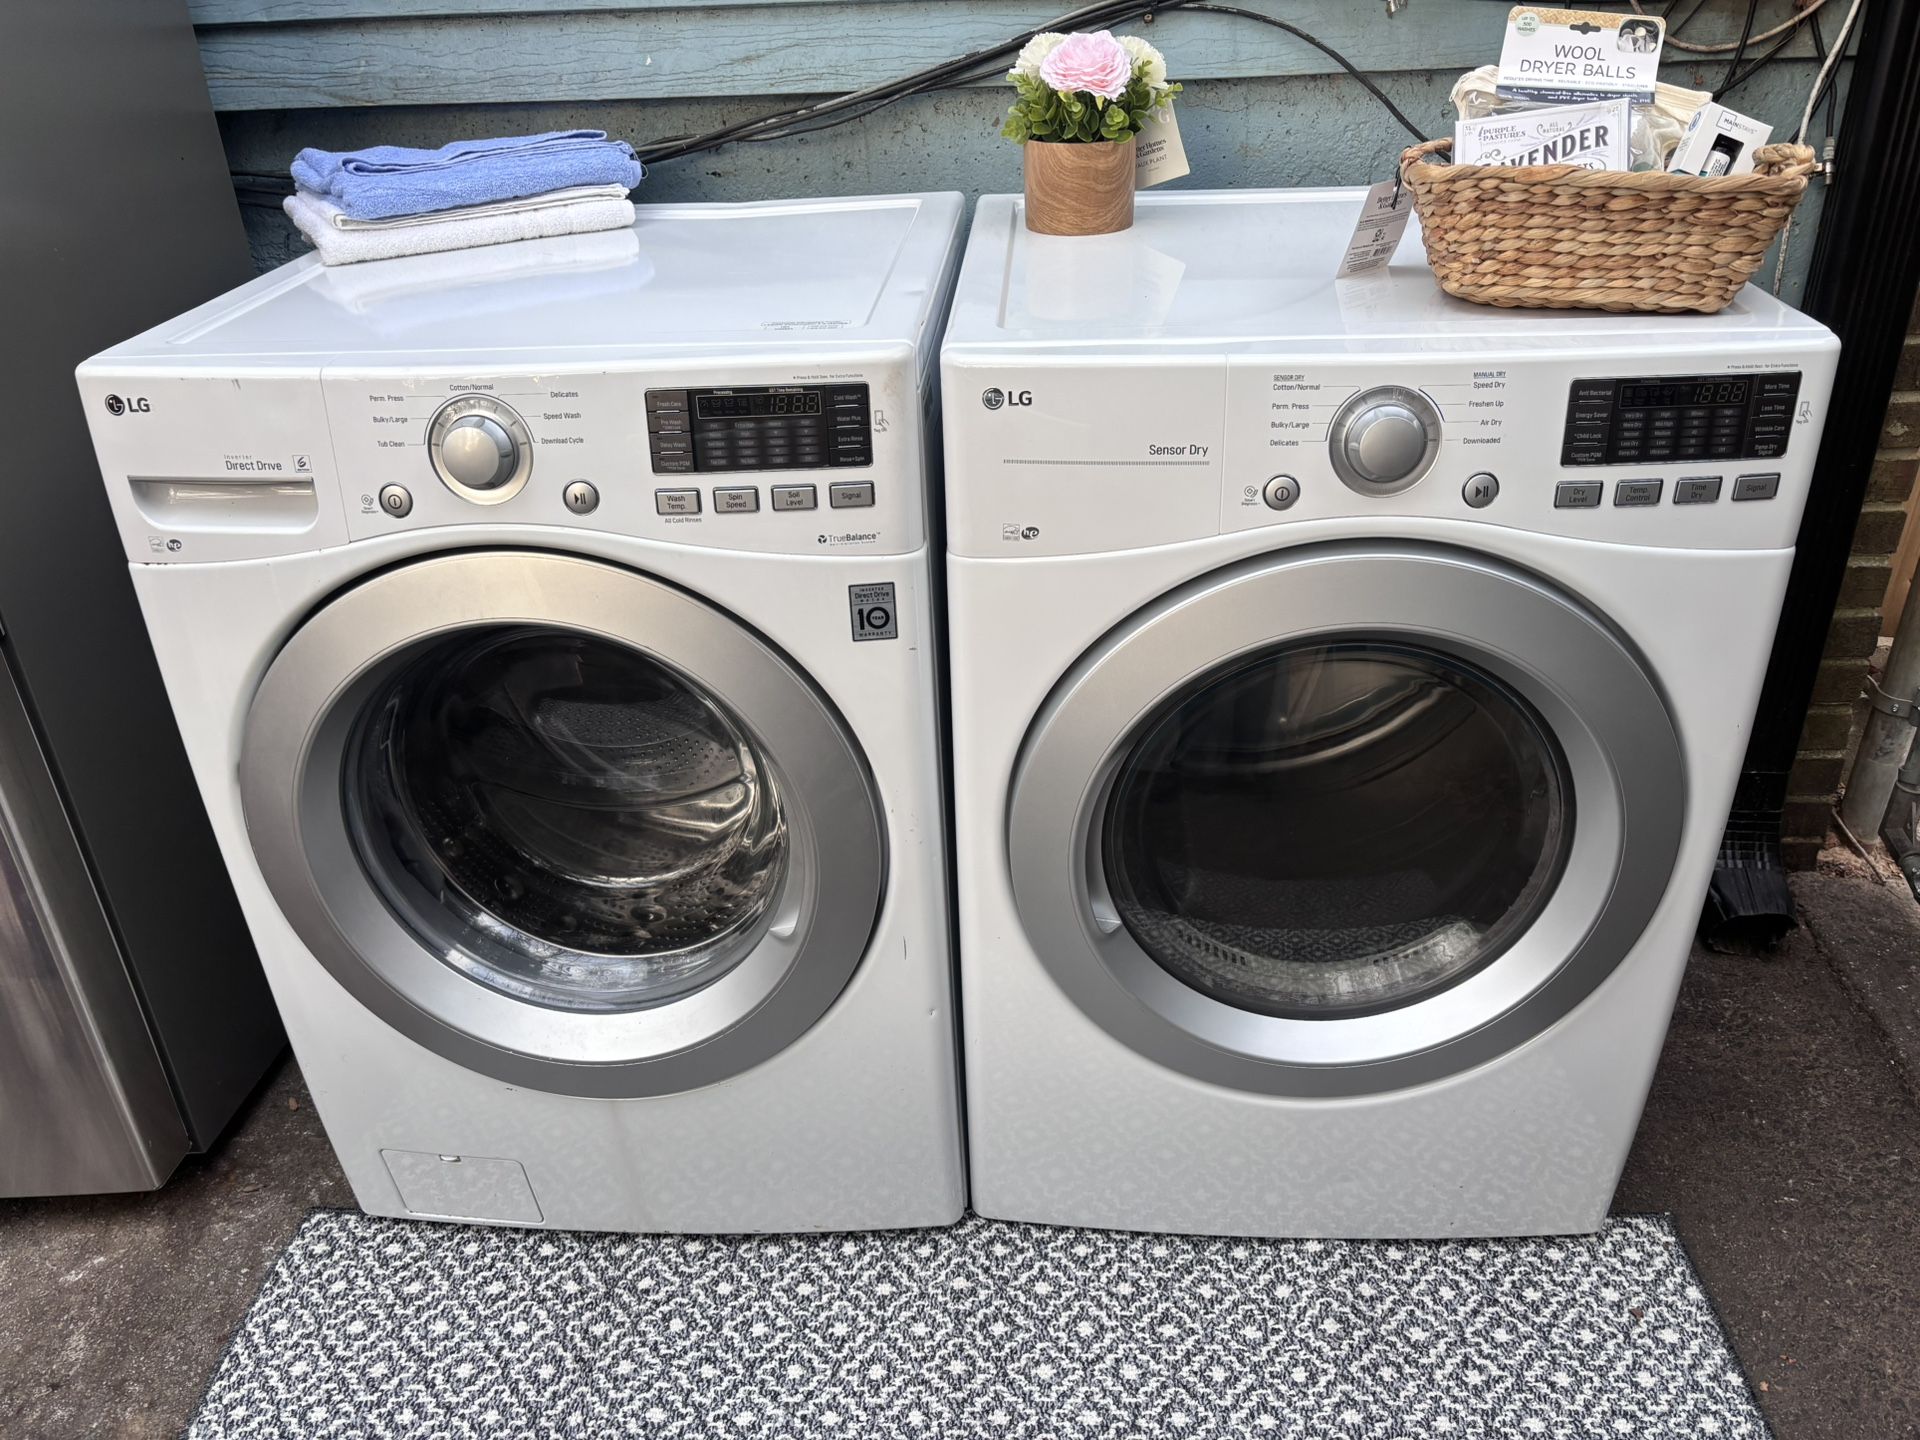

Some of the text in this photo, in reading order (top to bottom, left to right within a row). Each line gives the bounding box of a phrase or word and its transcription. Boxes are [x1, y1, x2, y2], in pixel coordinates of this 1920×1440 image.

[1554, 44, 1606, 61] WOOL
[1520, 60, 1636, 79] DRYER BALLS
[1482, 131, 1526, 142] PASTURES
[1483, 126, 1517, 135] PURPLE
[1482, 126, 1609, 167] VENDER
[1008, 391, 1032, 406] LG
[127, 398, 150, 412] LG
[1149, 445, 1208, 457] Sensor Dry
[226, 460, 282, 470] Direct Drive
[1574, 488, 1585, 496] Dry
[1746, 484, 1767, 492] Signal
[1691, 491, 1702, 499] Dry
[857, 607, 890, 630] 10
